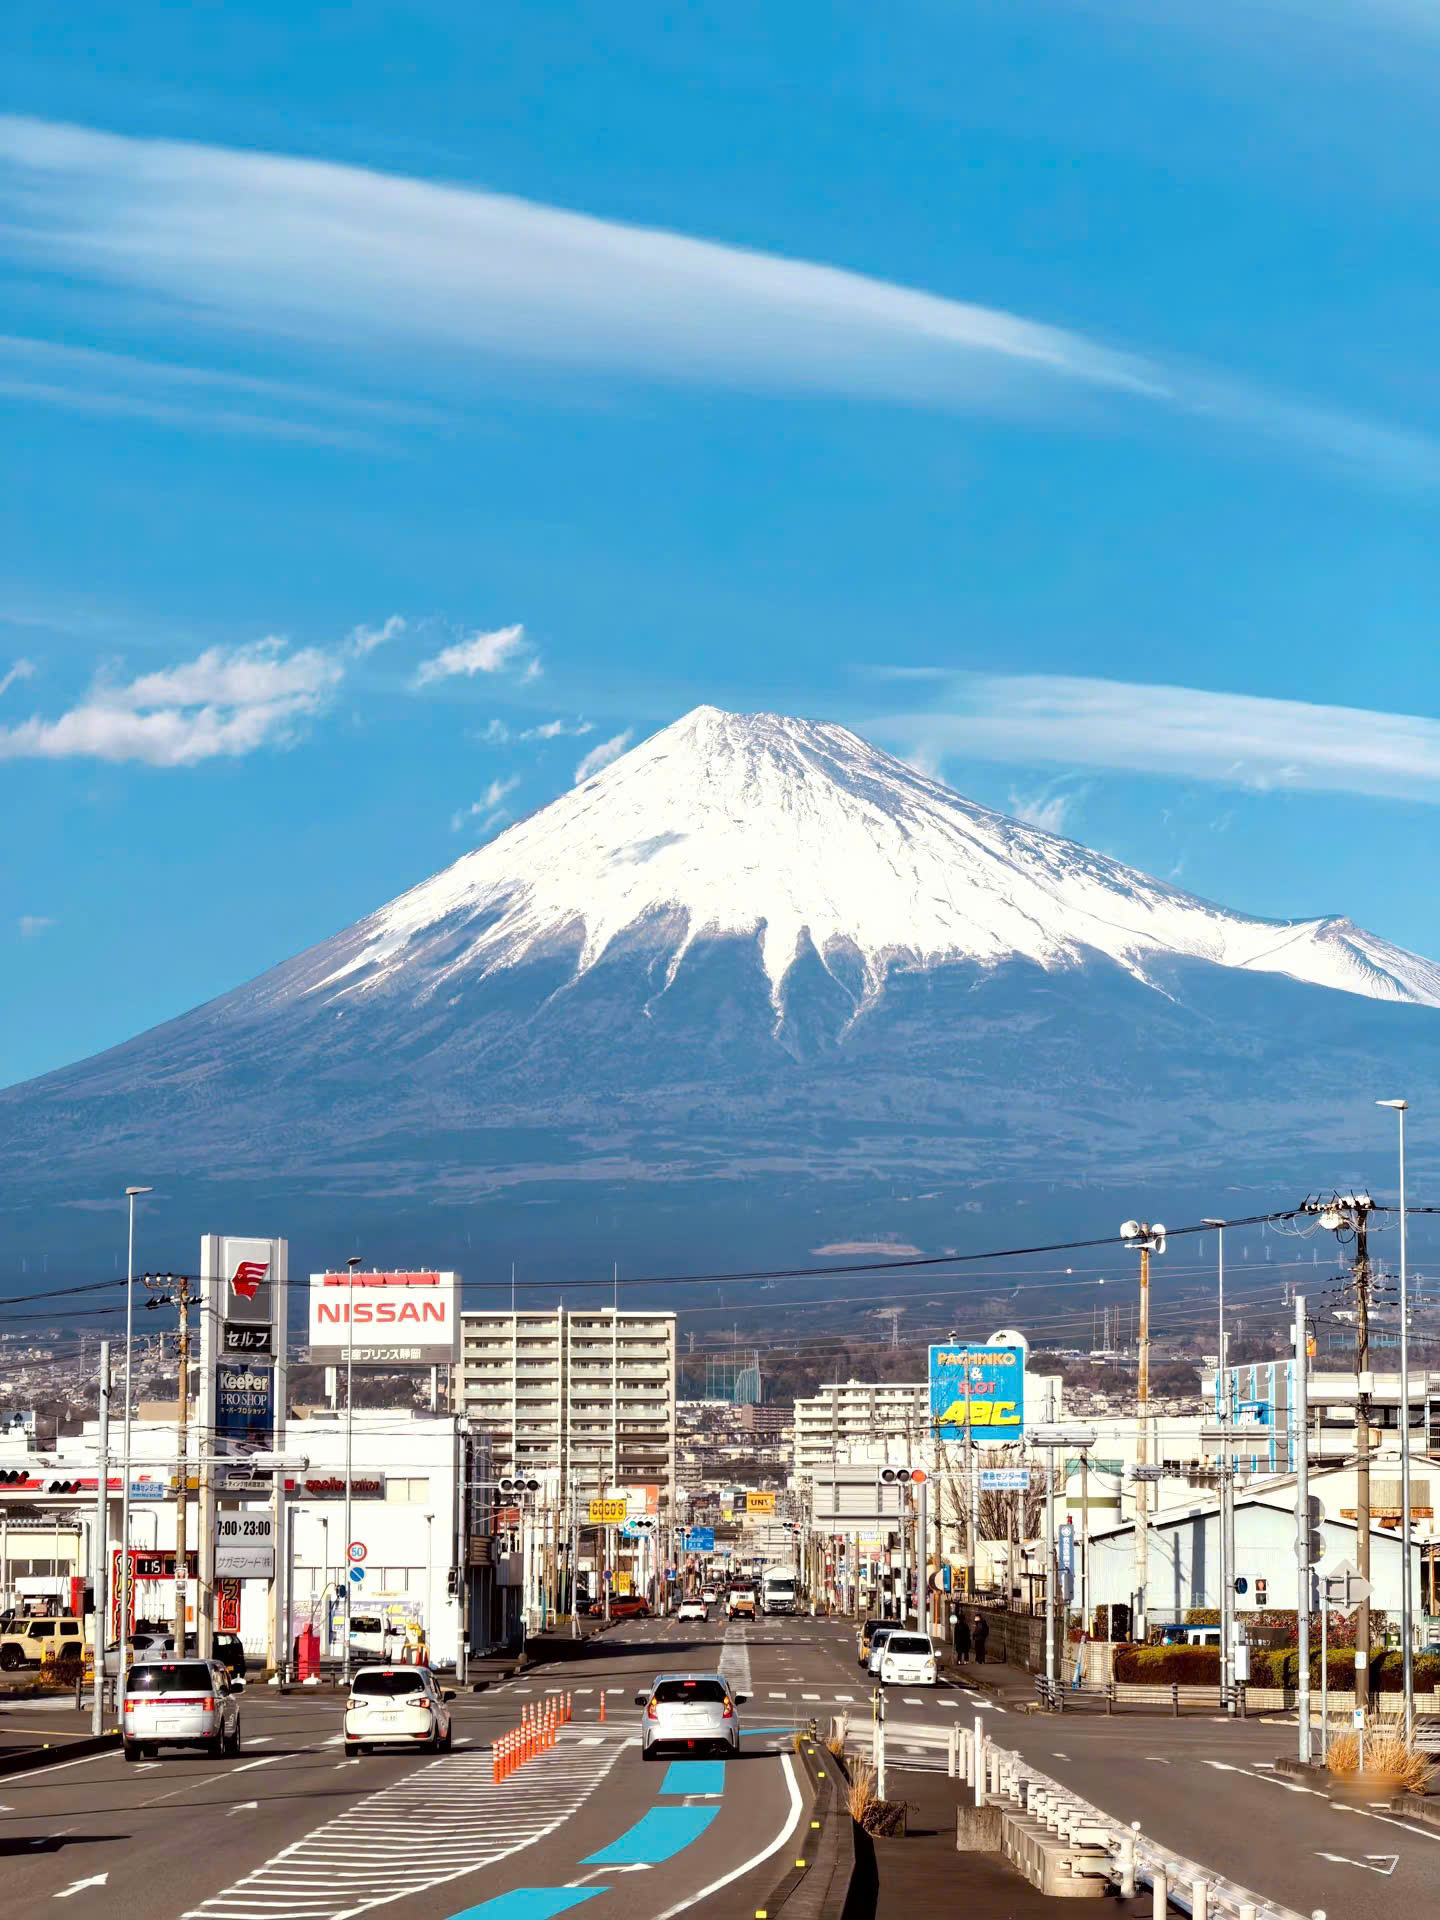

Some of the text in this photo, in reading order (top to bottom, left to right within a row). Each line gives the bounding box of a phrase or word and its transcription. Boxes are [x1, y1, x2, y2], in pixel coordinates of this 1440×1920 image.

[318, 1302, 445, 1323] NISSAN
[227, 1330, 268, 1347] セルフ
[341, 1349, 421, 1360] 日産プリンス静岡
[937, 1353, 1017, 1366] PACHINKO
[970, 1367, 983, 1380] &
[220, 1371, 269, 1391] KeePer
[958, 1382, 996, 1395] SLOT
[221, 1394, 267, 1406] PRO SHOP
[933, 1401, 1021, 1426] ABC
[592, 1502, 624, 1515] COCO'S
[217, 1521, 271, 1535] 7:00 23:00
[351, 1547, 363, 1557] 50
